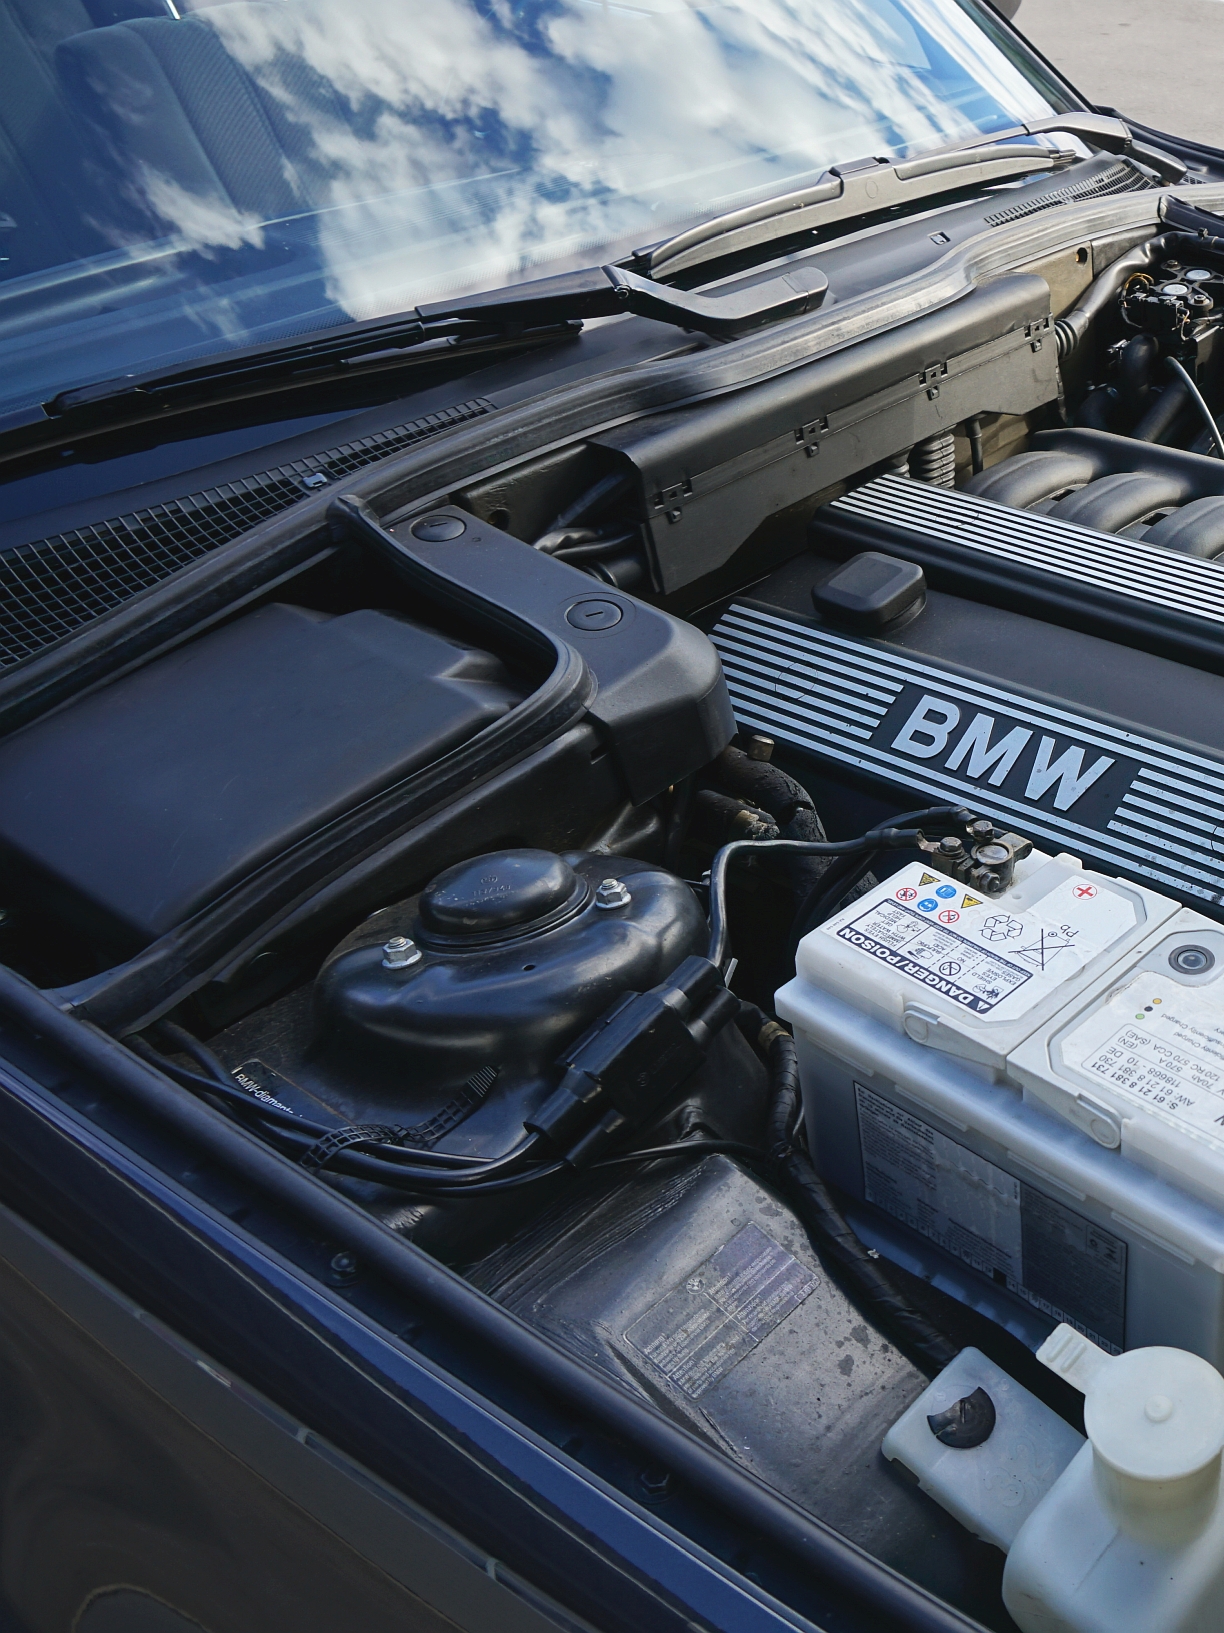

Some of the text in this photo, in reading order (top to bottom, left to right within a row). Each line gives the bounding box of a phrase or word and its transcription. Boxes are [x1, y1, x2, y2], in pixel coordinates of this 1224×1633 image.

[890, 695, 1116, 812] BMW
[872, 909, 898, 923] MEDICAL
[886, 911, 902, 920] HELP
[891, 909, 906, 917] FAST
[863, 927, 897, 946] FLUSH EYES
[864, 923, 902, 943] IMMEDIATELY
[871, 921, 906, 940] WITH WATER
[1060, 923, 1080, 938] Pb
[837, 927, 975, 1003] DANGER/POISON
[970, 971, 993, 984] SHIELD
[980, 971, 997, 981] EYES
[985, 967, 1016, 985] EXPLOSIVE
[1000, 970, 1021, 981] GASES
[1160, 1012, 1190, 1029] Charged
[1116, 1035, 1139, 1049] (EN)
[1172, 1030, 1202, 1047] Charged
[1105, 1045, 1124, 1057] DE
[1124, 1028, 1221, 1081] 120 RC 570 CCA (SAE)
[1125, 1056, 1140, 1066] 10
[1156, 1056, 1167, 1064] A
[1164, 1060, 1183, 1072] 570
[1097, 1053, 1195, 1106] AW: 61 21 8 381 730
[1146, 1066, 1182, 1087] 118668
[1189, 1073, 1214, 1088] 70Ah
[1090, 1061, 1179, 1110] S: 61 21 8 381 731
[235, 1073, 302, 1117] BMW-diamant
